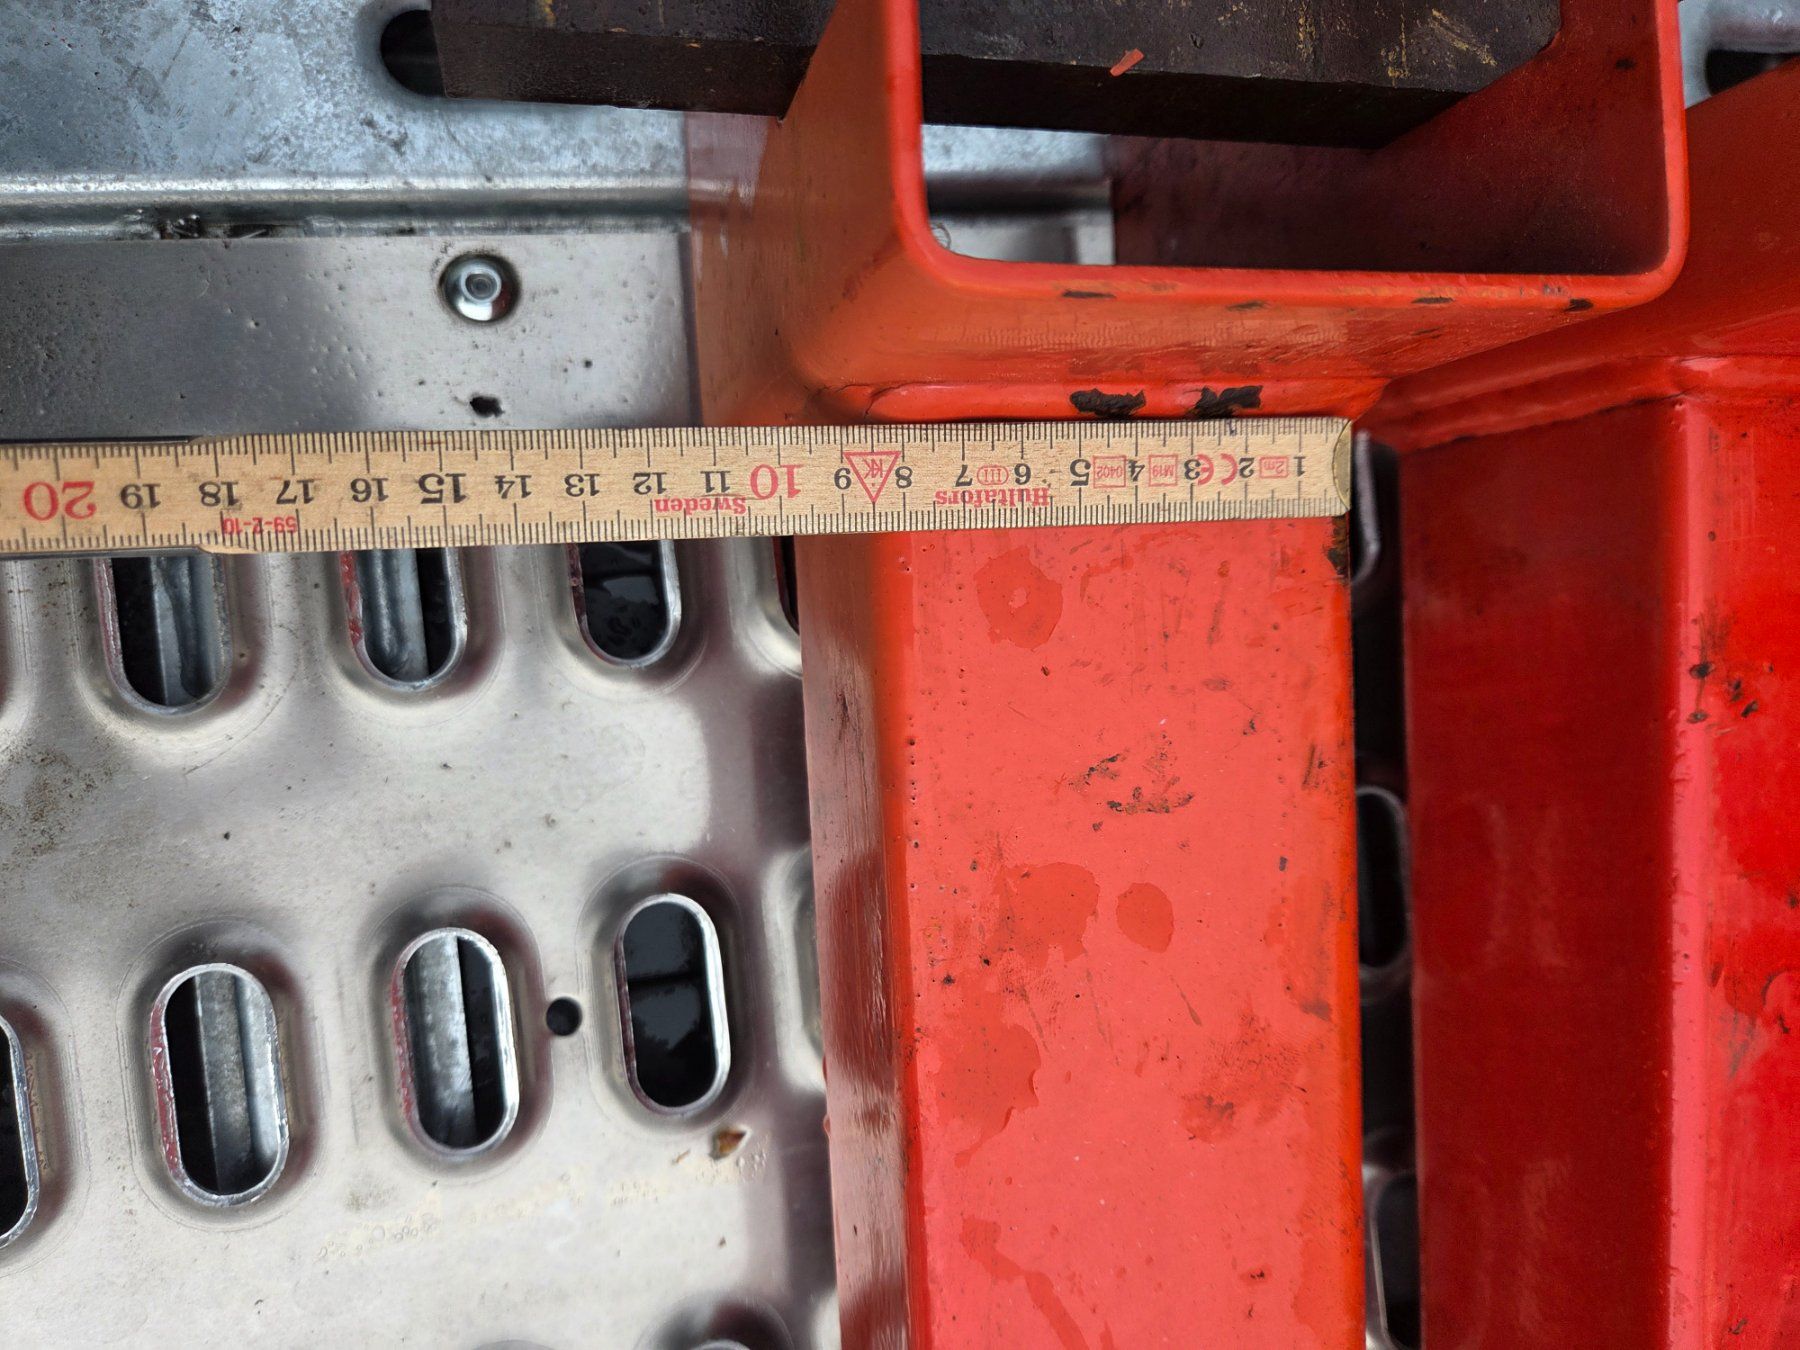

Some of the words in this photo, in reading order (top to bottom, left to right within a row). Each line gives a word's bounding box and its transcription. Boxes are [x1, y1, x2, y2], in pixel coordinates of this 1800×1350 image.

[895, 466, 913, 488] 8
[955, 464, 973, 487] 7
[1014, 463, 1031, 485] 6
[1070, 459, 1091, 486] 5
[1096, 465, 1123, 479] 0402
[1128, 459, 1145, 482] 4
[1183, 459, 1201, 480] 3
[1239, 457, 1255, 478] 2
[1263, 461, 1286, 474] 2m
[1294, 456, 1306, 477] 1
[350, 478, 389, 502] 16
[418, 473, 467, 504] 15
[494, 474, 532, 499] 14
[564, 473, 600, 497] 13
[633, 471, 667, 495] 12
[701, 470, 731, 493] 11
[749, 464, 803, 500] 10
[834, 467, 851, 490] 9
[23, 480, 97, 521] 20
[119, 483, 162, 509] 19
[199, 481, 240, 507] 18
[276, 479, 315, 504] 17
[934, 486, 1051, 508] Hultafors
[654, 496, 747, 515] Sweden
[222, 516, 298, 535] 59-2-10
